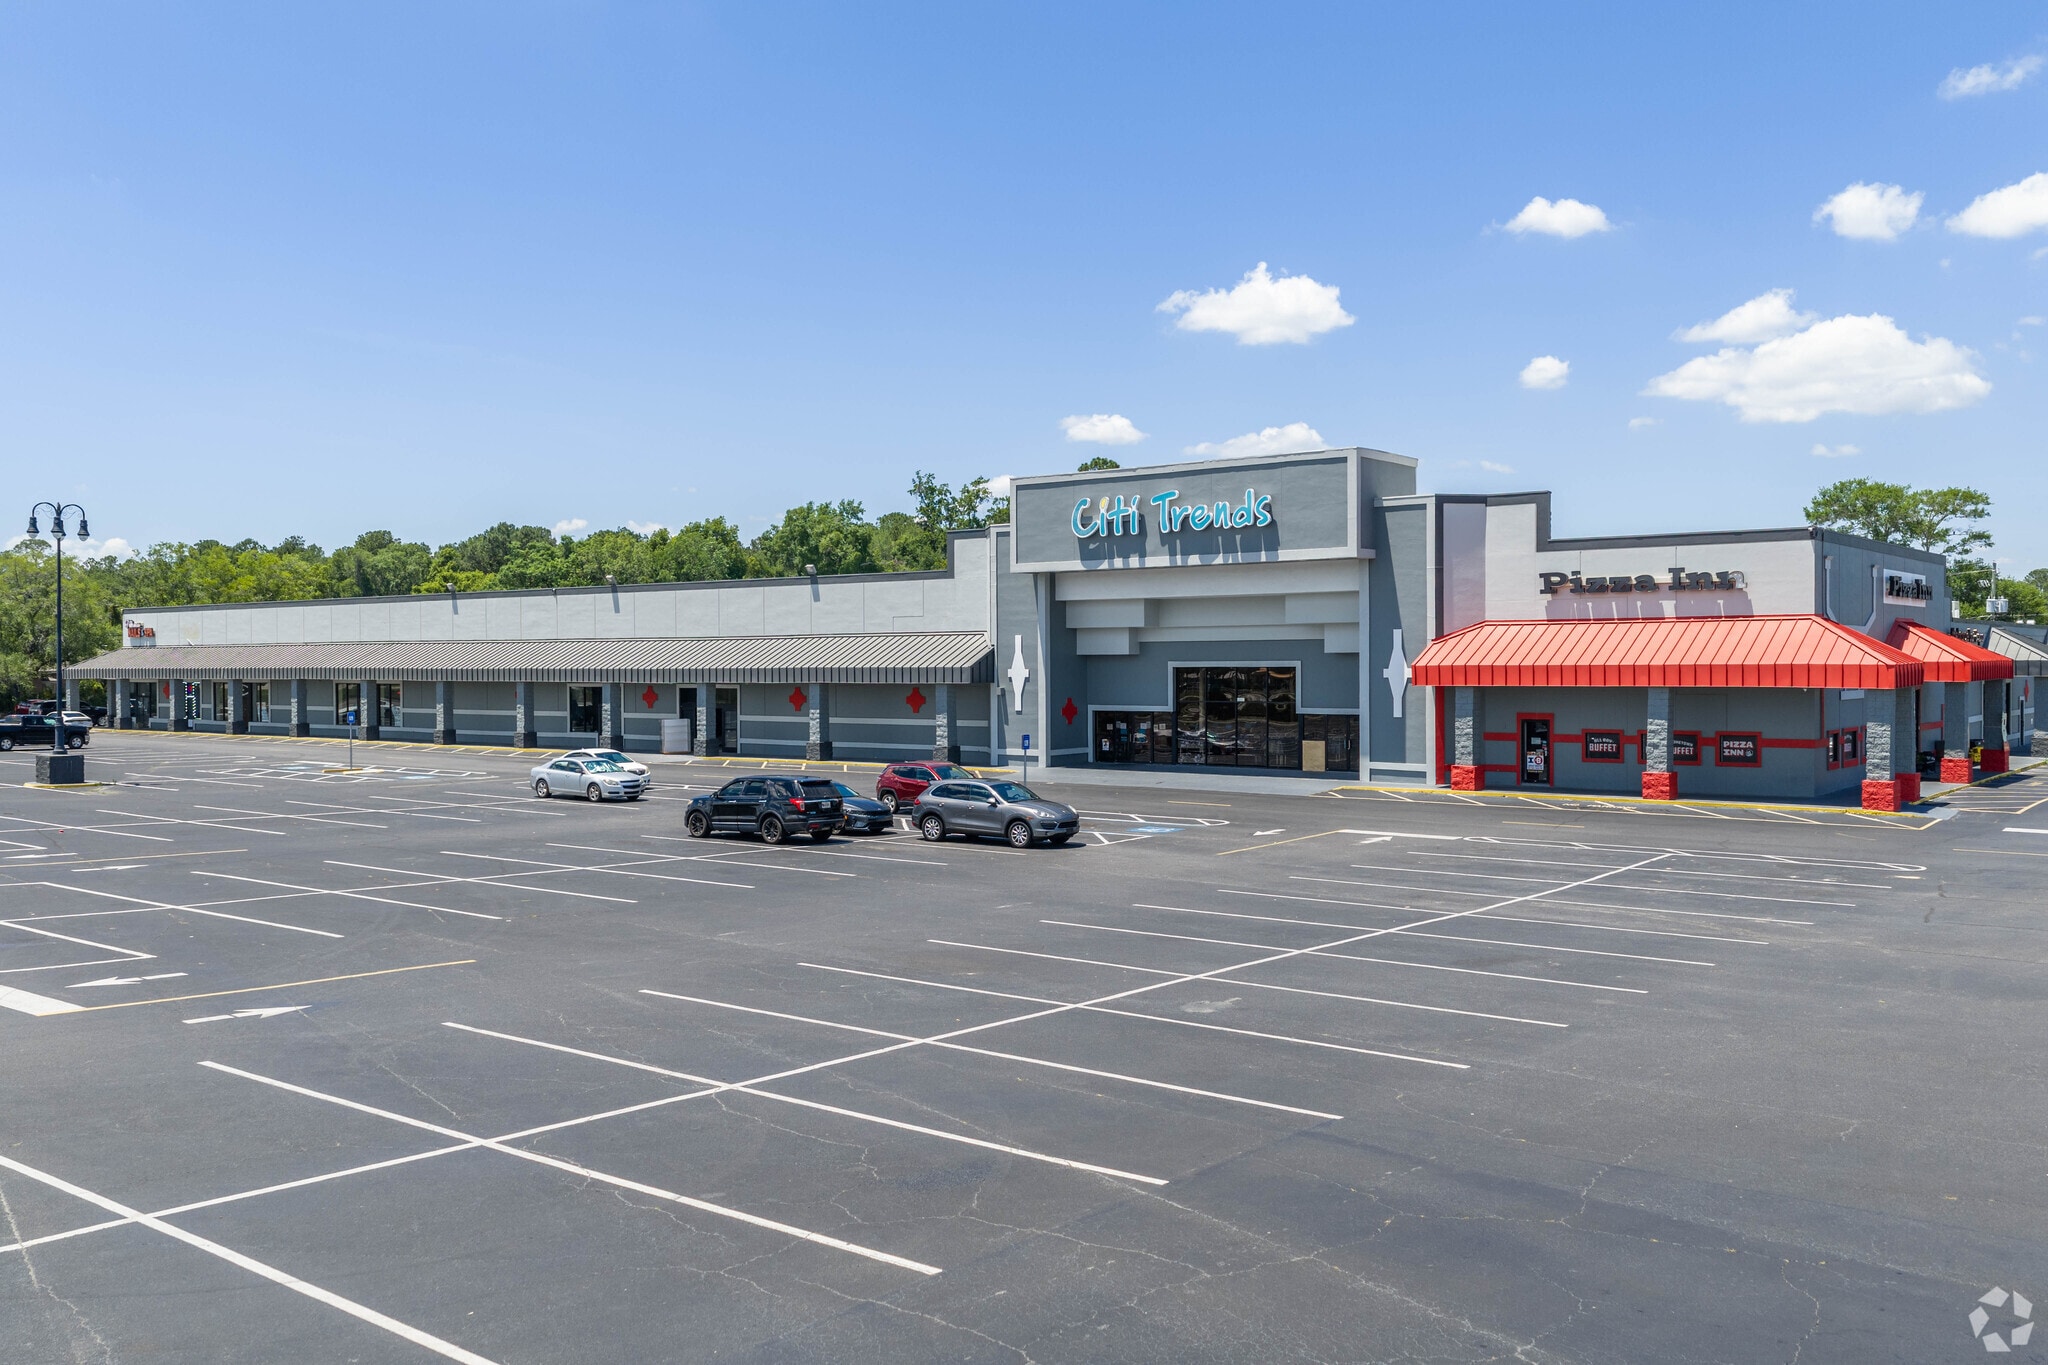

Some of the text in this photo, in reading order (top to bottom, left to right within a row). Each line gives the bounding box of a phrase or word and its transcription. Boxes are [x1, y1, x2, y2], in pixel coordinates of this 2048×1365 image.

[1071, 488, 1272, 538] Citi Trends
[1539, 567, 1749, 595] Pizza Inn
[1589, 743, 1617, 752] BUFFET
[1673, 747, 1694, 755] UFFET
